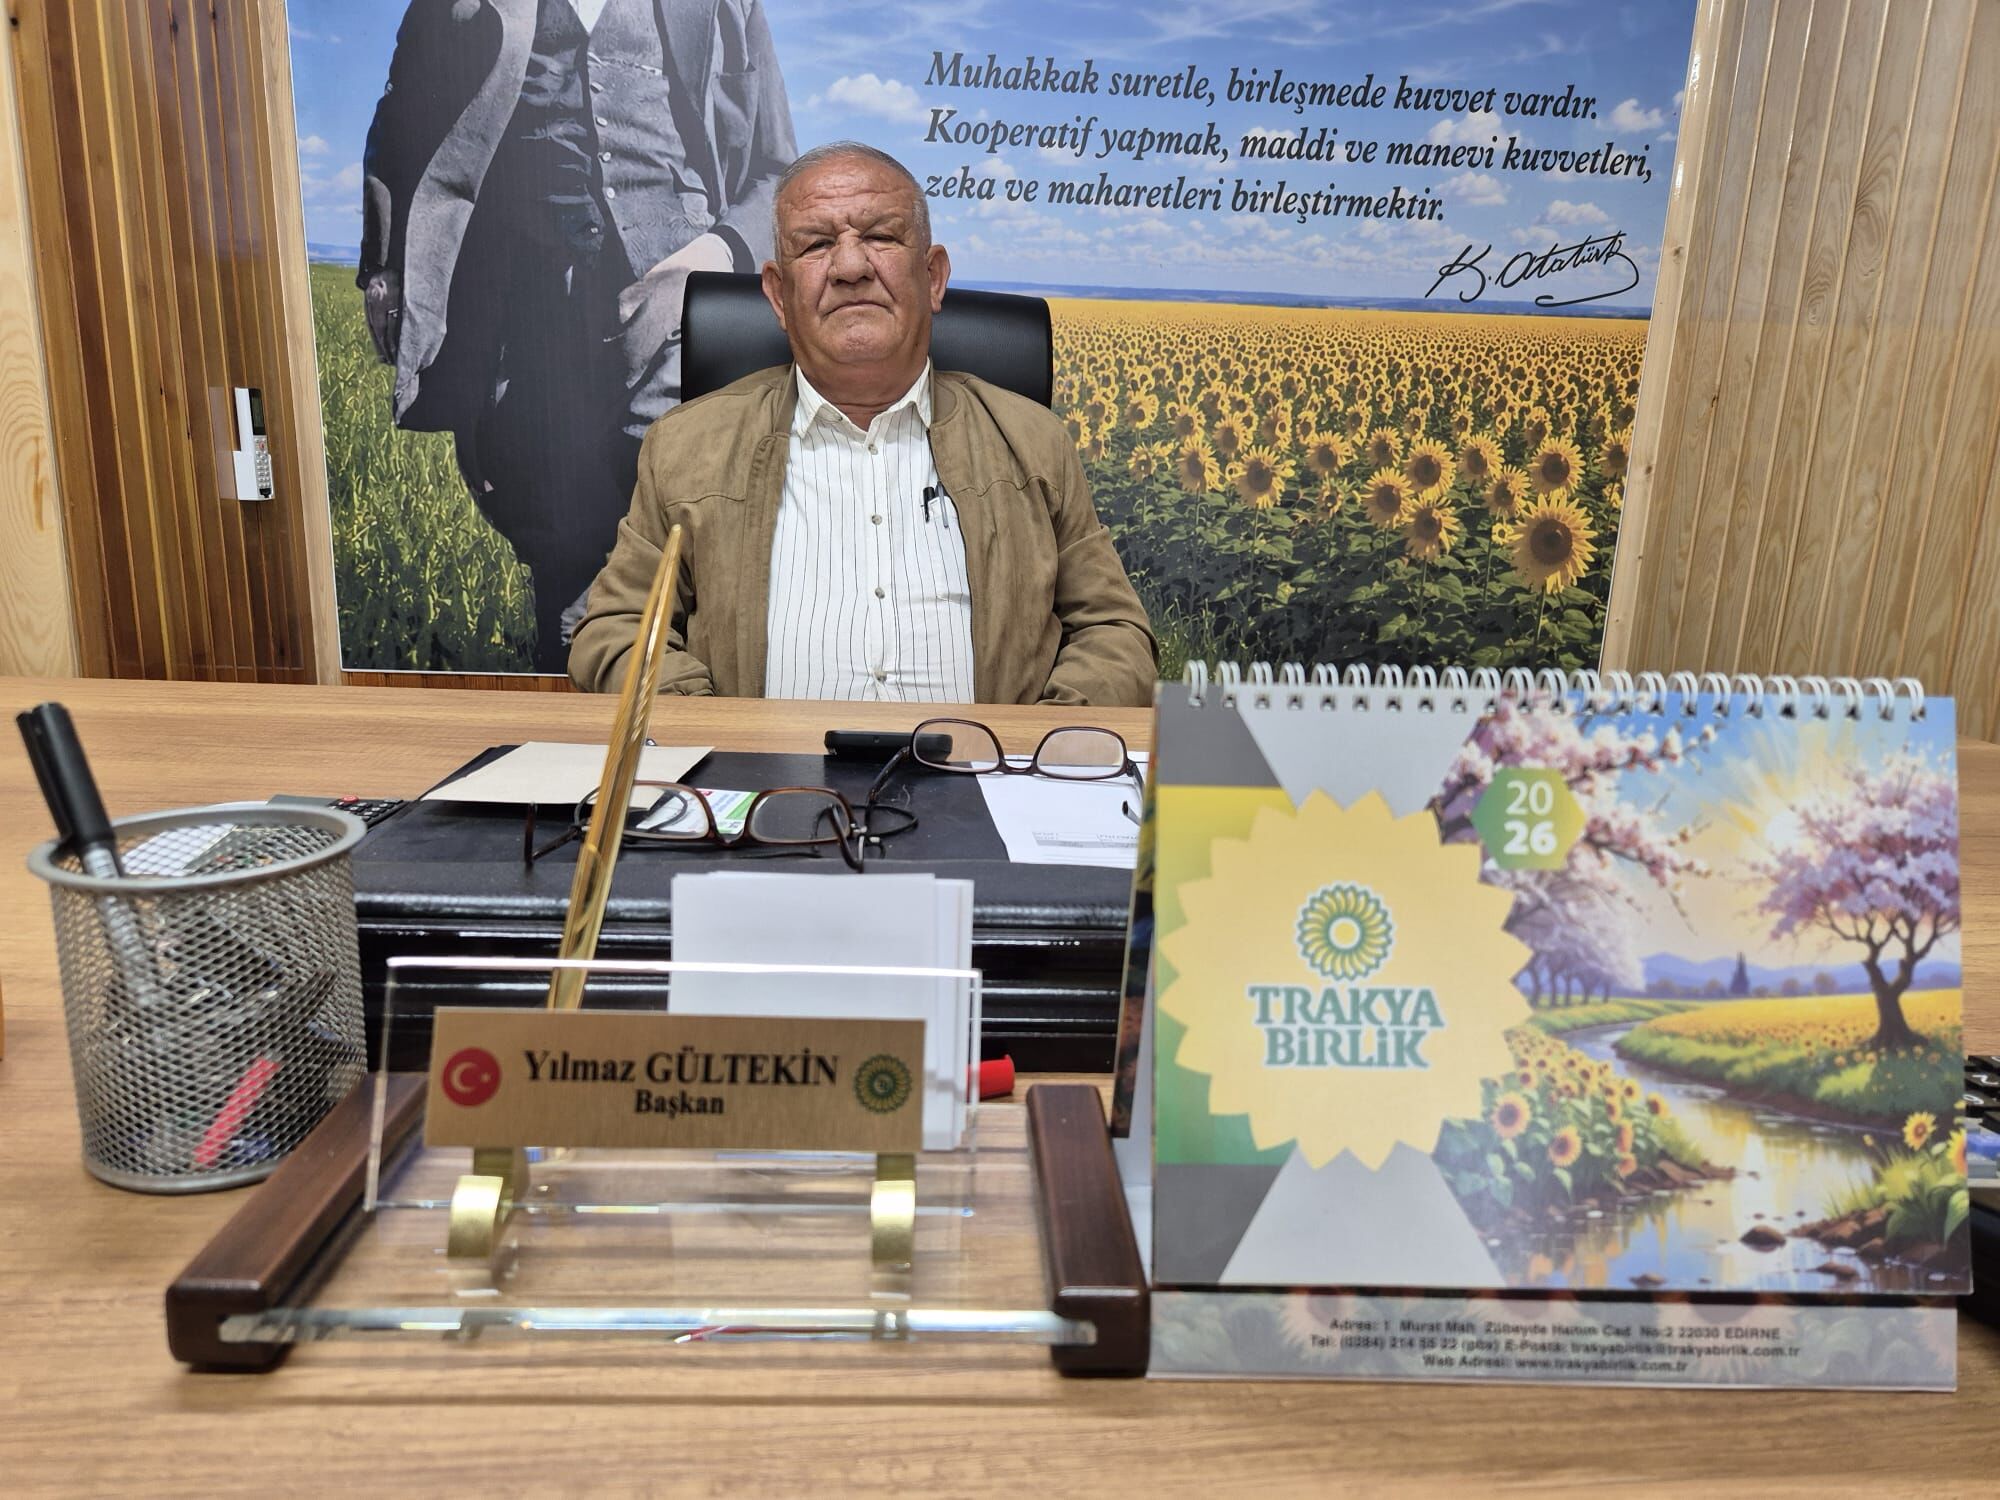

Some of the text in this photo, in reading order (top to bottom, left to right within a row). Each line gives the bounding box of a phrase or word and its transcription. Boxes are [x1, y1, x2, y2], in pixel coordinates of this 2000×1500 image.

[925, 51, 1597, 120] Muhakkak suretle, birleşmede kuvvet vardır.
[925, 108, 1652, 183] Kooperatif yapmak, maddi ve manevi kuvvetleri,
[925, 166, 1444, 224] zeka ve maharetleri birleştirmektir.
[1505, 780, 1553, 816] 20
[1503, 821, 1558, 857] 26
[1248, 985, 1446, 1028] TRAKYA
[524, 1046, 838, 1084] Yılmaz GÜLTEKİN
[634, 1088, 725, 1119] Başkan
